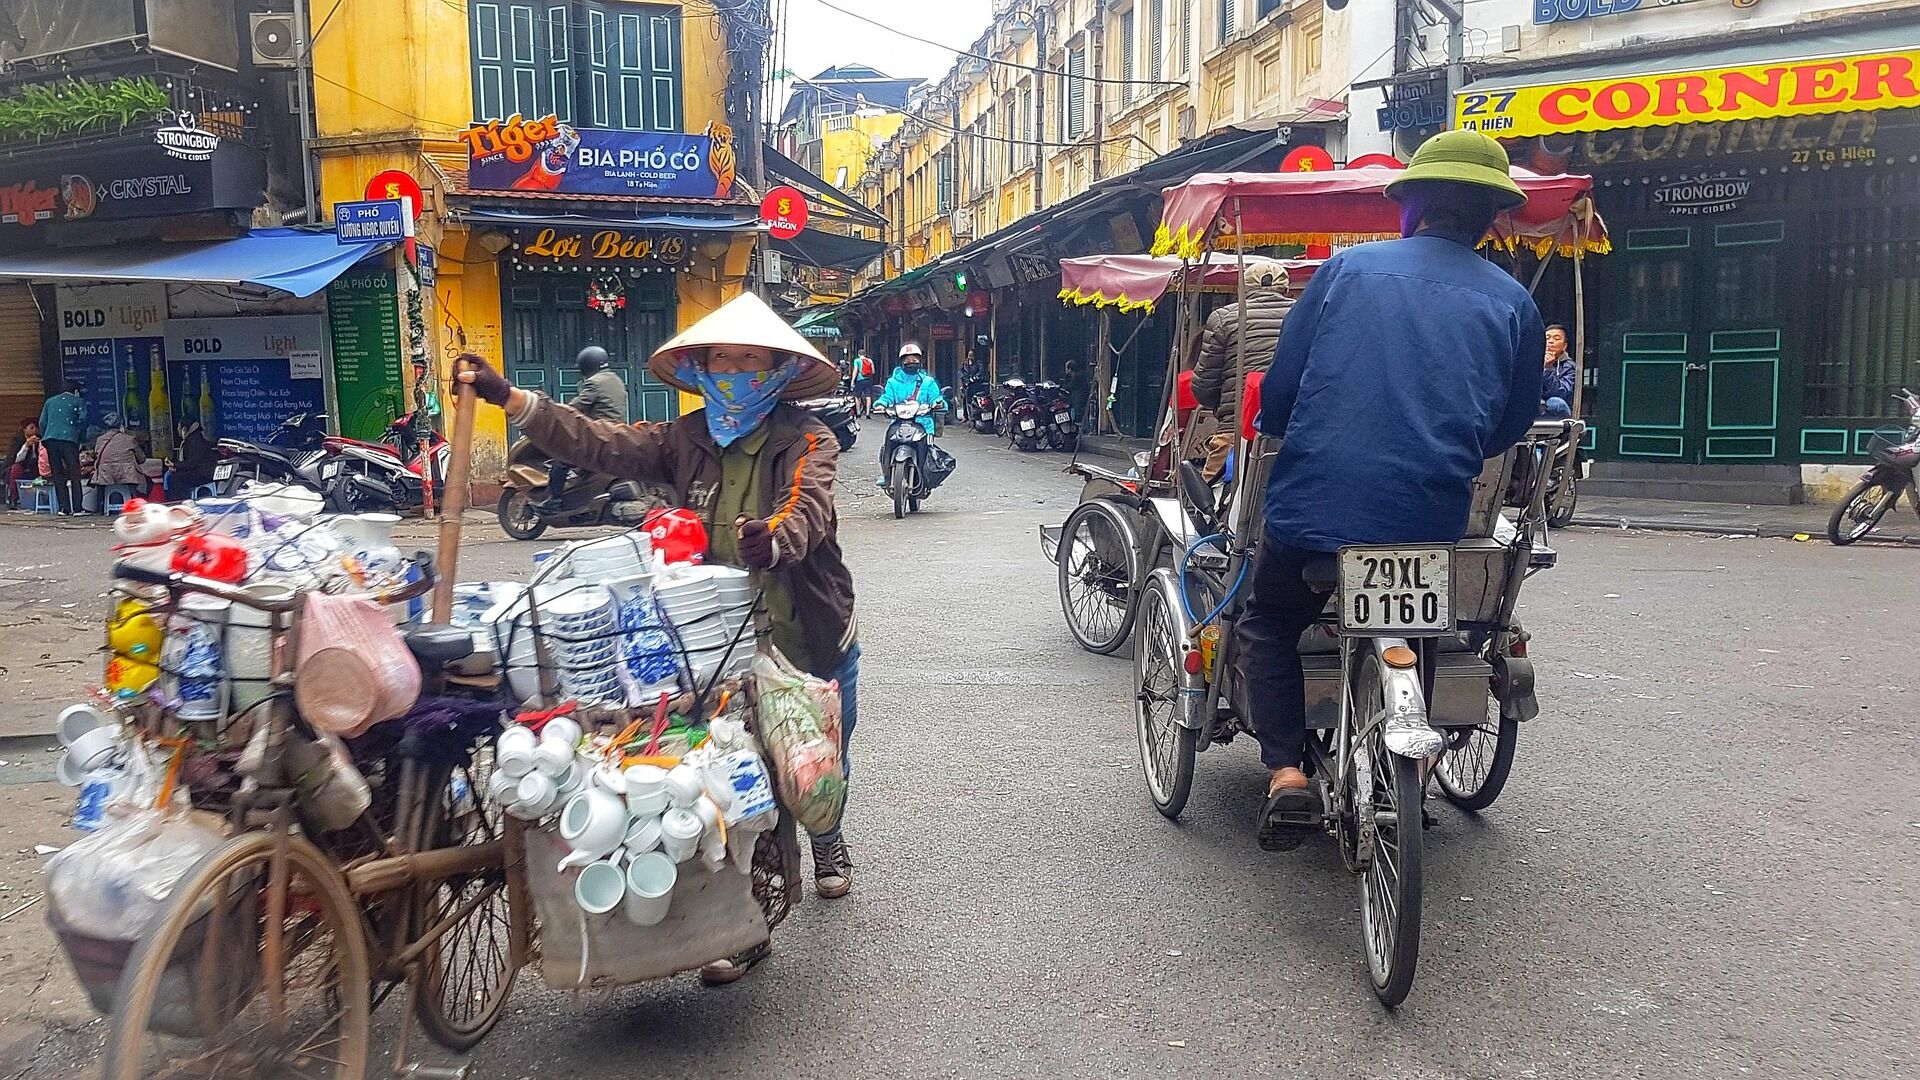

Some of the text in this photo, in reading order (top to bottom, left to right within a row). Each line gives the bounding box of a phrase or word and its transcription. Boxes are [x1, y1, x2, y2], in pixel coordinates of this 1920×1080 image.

[1539, 57, 1920, 124] CORNER
[1462, 92, 1517, 116] 27
[1377, 100, 1447, 132] BOLD
[156, 131, 221, 150] STRONGBOW
[459, 112, 561, 164] Tiger
[167, 149, 187, 160] APPLE
[480, 153, 504, 166] SINCE
[578, 145, 700, 171] BIA PHỐ CỔ
[1791, 150, 1810, 164] 27
[640, 172, 658, 180] COLD
[659, 173, 677, 181] BEER
[110, 174, 191, 200] CRYSTAL
[1654, 181, 1751, 202] STRONGBOW
[357, 205, 380, 218] PHỐ
[1669, 201, 1737, 215] APPLE CIDERS
[767, 219, 798, 231] SAIGON
[591, 230, 651, 259] Béo
[660, 236, 683, 254] 18
[334, 279, 350, 290] BIA
[63, 304, 159, 331] BOLD Light
[65, 346, 78, 356] BIA
[184, 335, 298, 356] BOLD Light
[1363, 557, 1430, 589] 29XL
